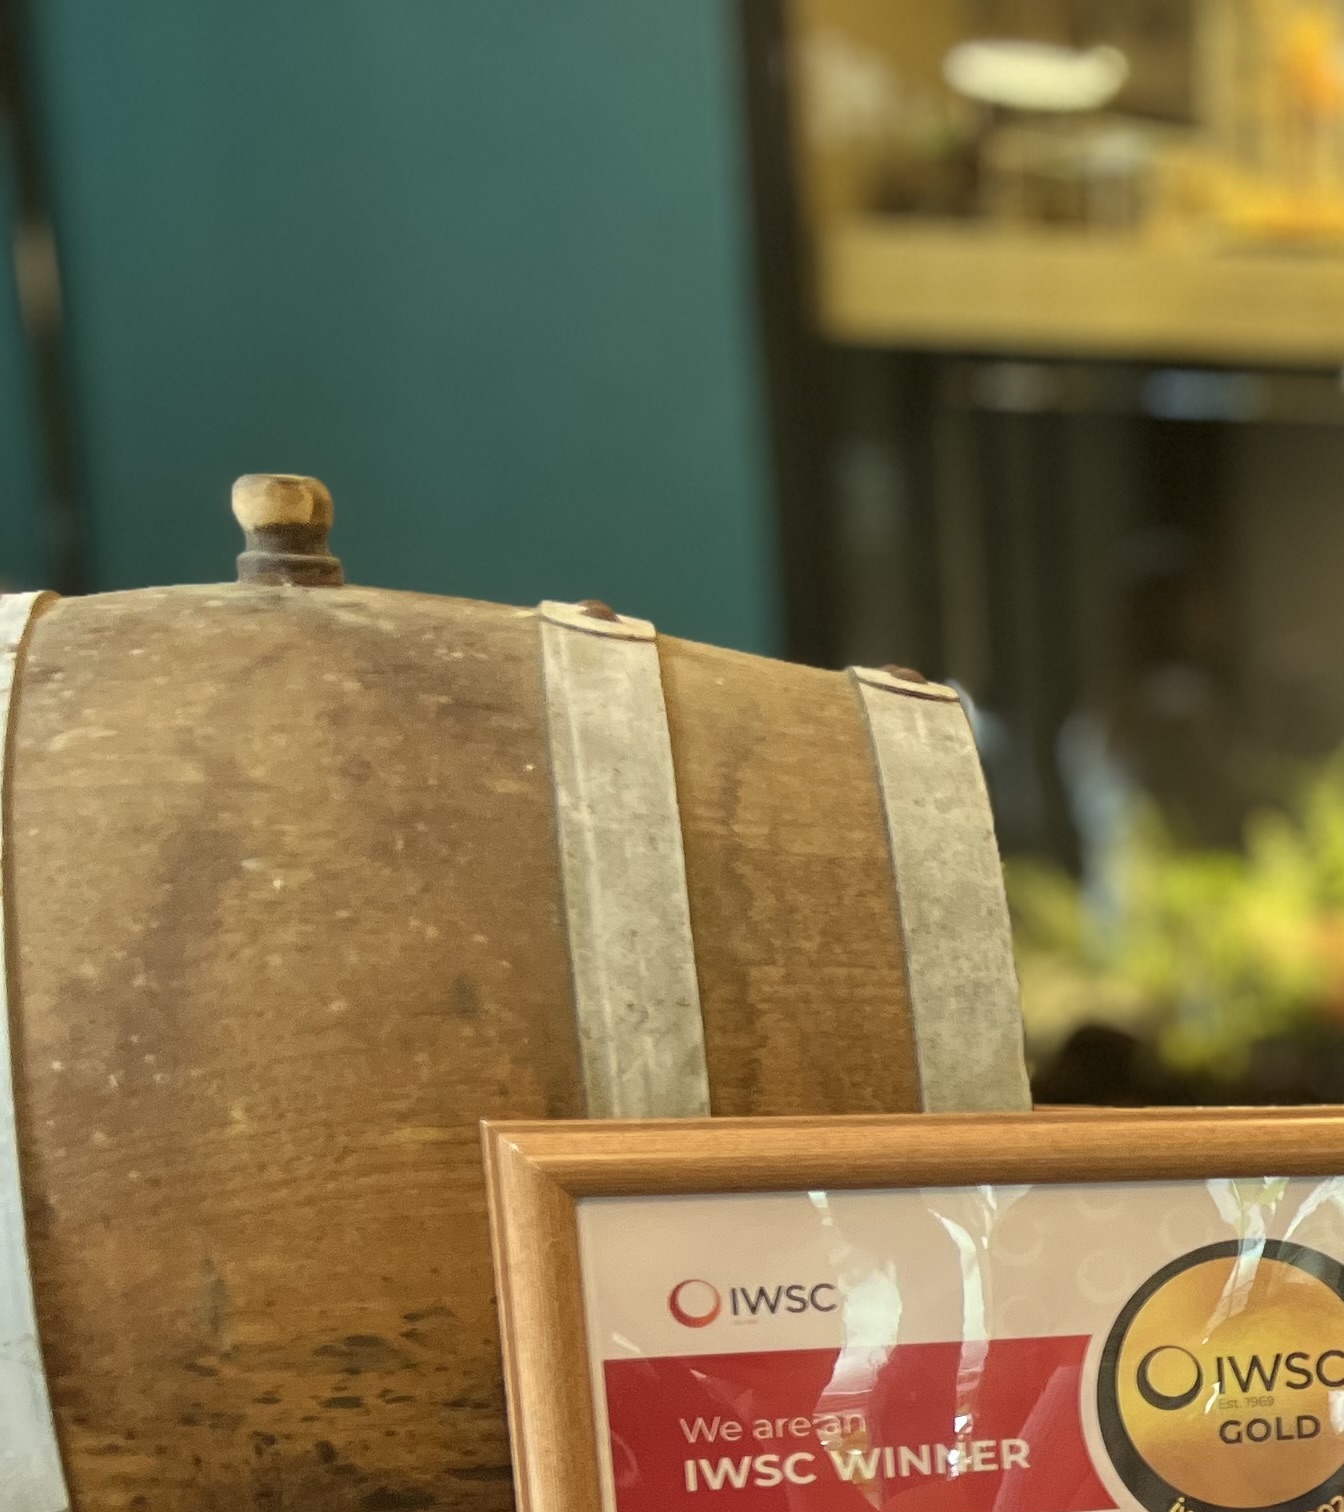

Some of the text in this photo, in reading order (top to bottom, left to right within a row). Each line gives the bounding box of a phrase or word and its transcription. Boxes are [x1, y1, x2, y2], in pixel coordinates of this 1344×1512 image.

[729, 1282, 838, 1317] IWSC
[679, 1412, 867, 1443] We are an
[1218, 1414, 1322, 1445] GOLD
[684, 1438, 1031, 1492] IWSC WINNER
